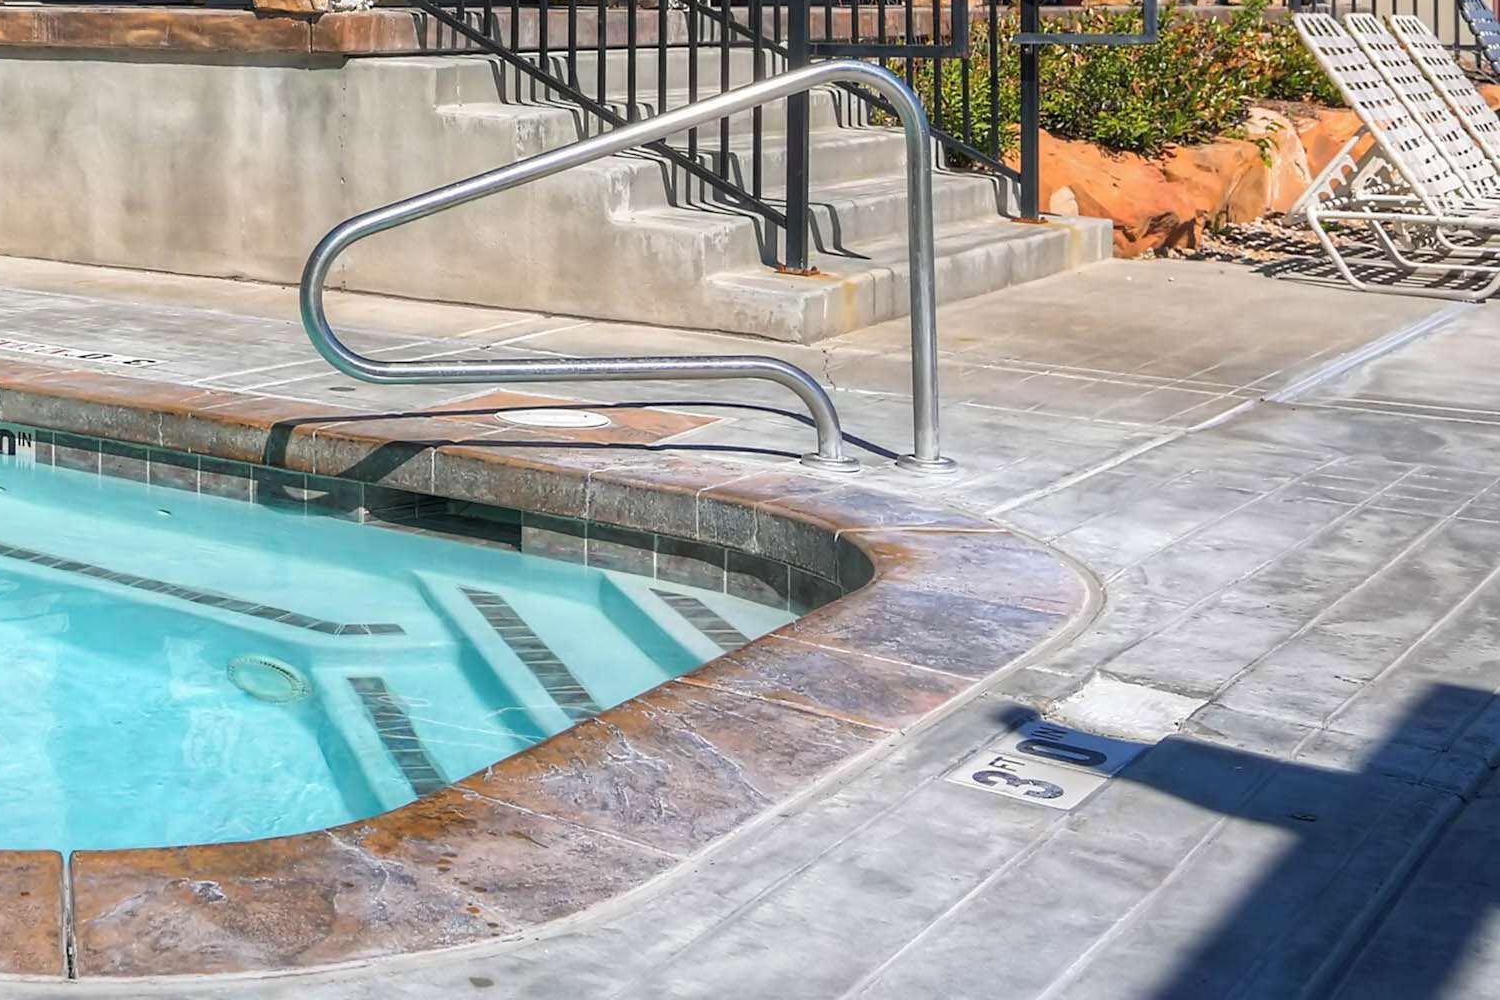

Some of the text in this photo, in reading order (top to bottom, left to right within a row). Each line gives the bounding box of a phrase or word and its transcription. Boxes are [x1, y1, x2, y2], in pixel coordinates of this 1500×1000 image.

[18, 431, 32, 448] IN
[1015, 725, 1108, 767] 0 IN
[971, 755, 1065, 800] 3 FT
